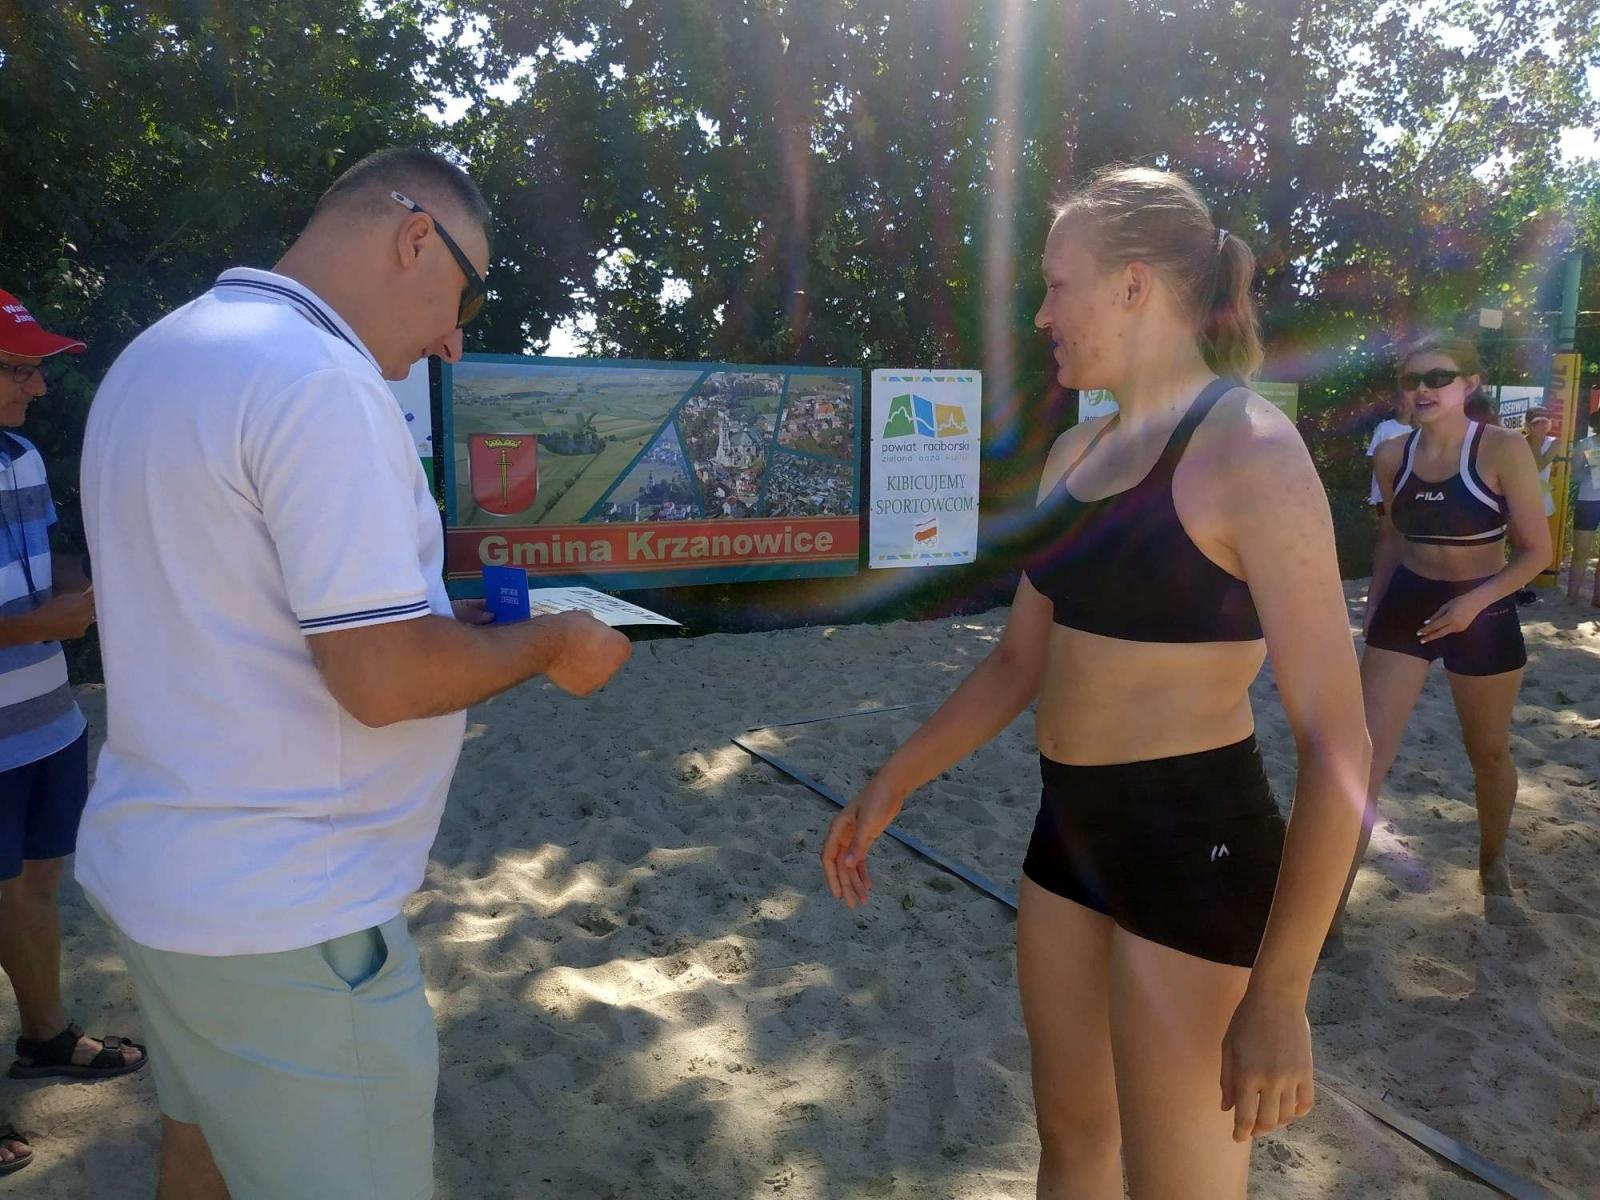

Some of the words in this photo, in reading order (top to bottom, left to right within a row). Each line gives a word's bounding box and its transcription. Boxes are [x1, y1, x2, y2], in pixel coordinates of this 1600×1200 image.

[881, 442, 917, 455] powiat
[923, 440, 970, 451] raciborski
[887, 473, 967, 492] KIBICUJEMY
[876, 496, 974, 515] SPORTOWCOM
[1415, 491, 1445, 501] FILA
[478, 534, 612, 567] Gmina
[627, 526, 835, 561] Krzanowice
